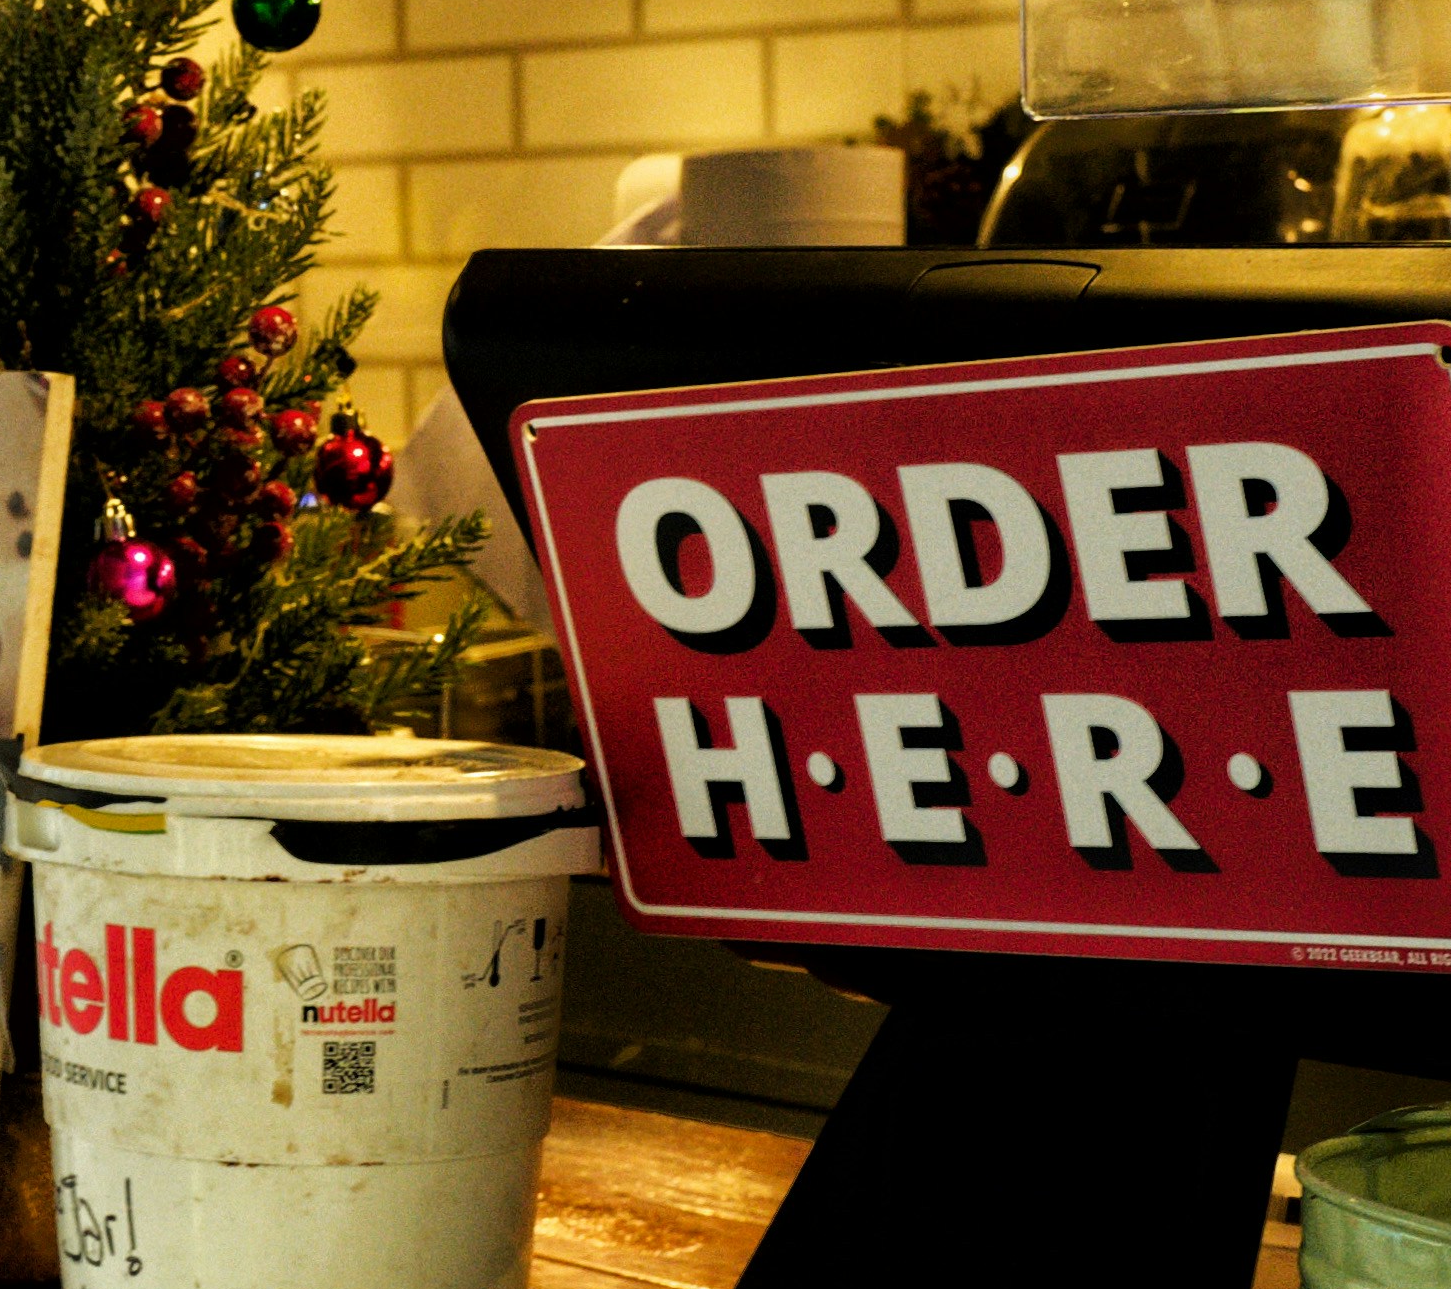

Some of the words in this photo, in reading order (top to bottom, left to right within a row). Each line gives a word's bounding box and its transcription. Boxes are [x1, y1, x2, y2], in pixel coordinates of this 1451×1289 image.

[615, 439, 1383, 641] ORDER
[1306, 947, 1337, 961] 2022
[1407, 951, 1428, 965] ALL
[37, 920, 243, 1053] tella
[301, 998, 396, 1025] nutella
[64, 1061, 128, 1095] SERVICE
